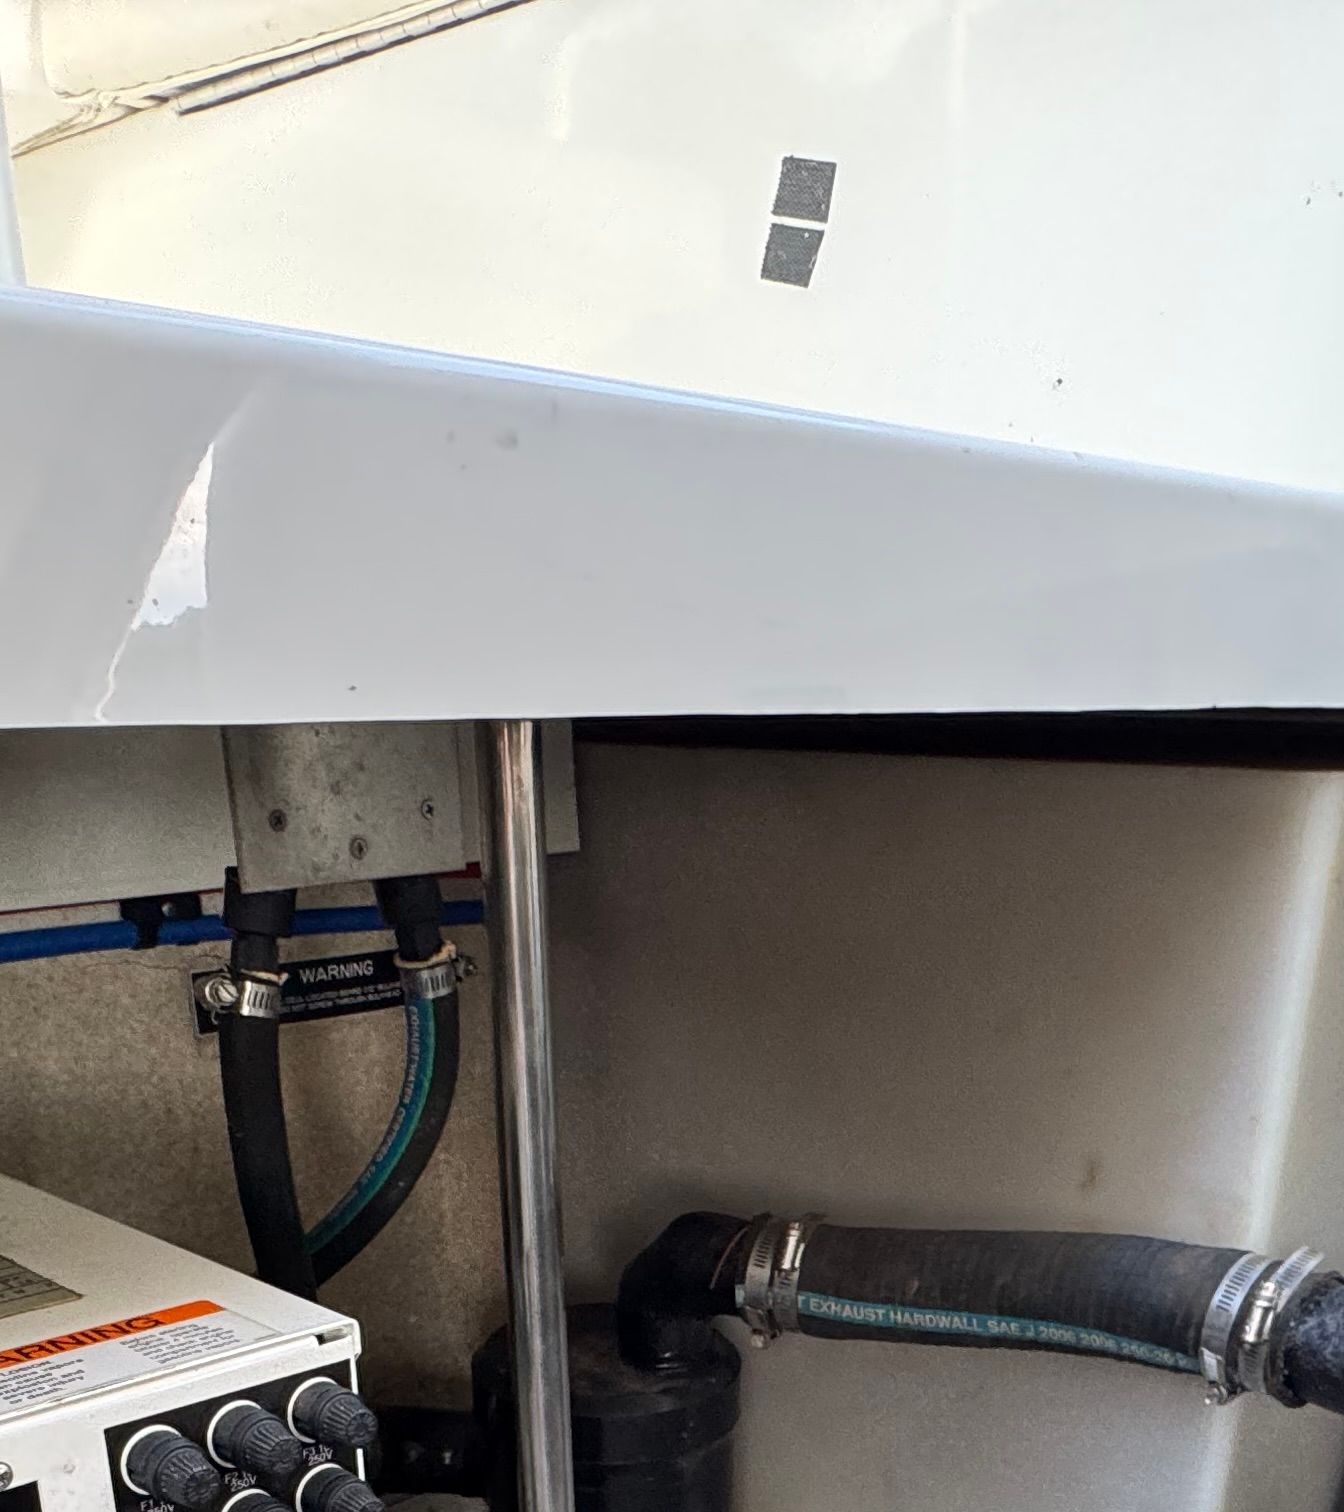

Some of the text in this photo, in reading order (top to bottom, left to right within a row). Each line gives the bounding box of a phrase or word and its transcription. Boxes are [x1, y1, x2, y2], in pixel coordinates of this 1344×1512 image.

[299, 960, 374, 983] WARNING
[809, 1298, 885, 1322] EXHAUST
[890, 1310, 984, 1331] HARDWALL
[987, 1319, 1021, 1336] SAE
